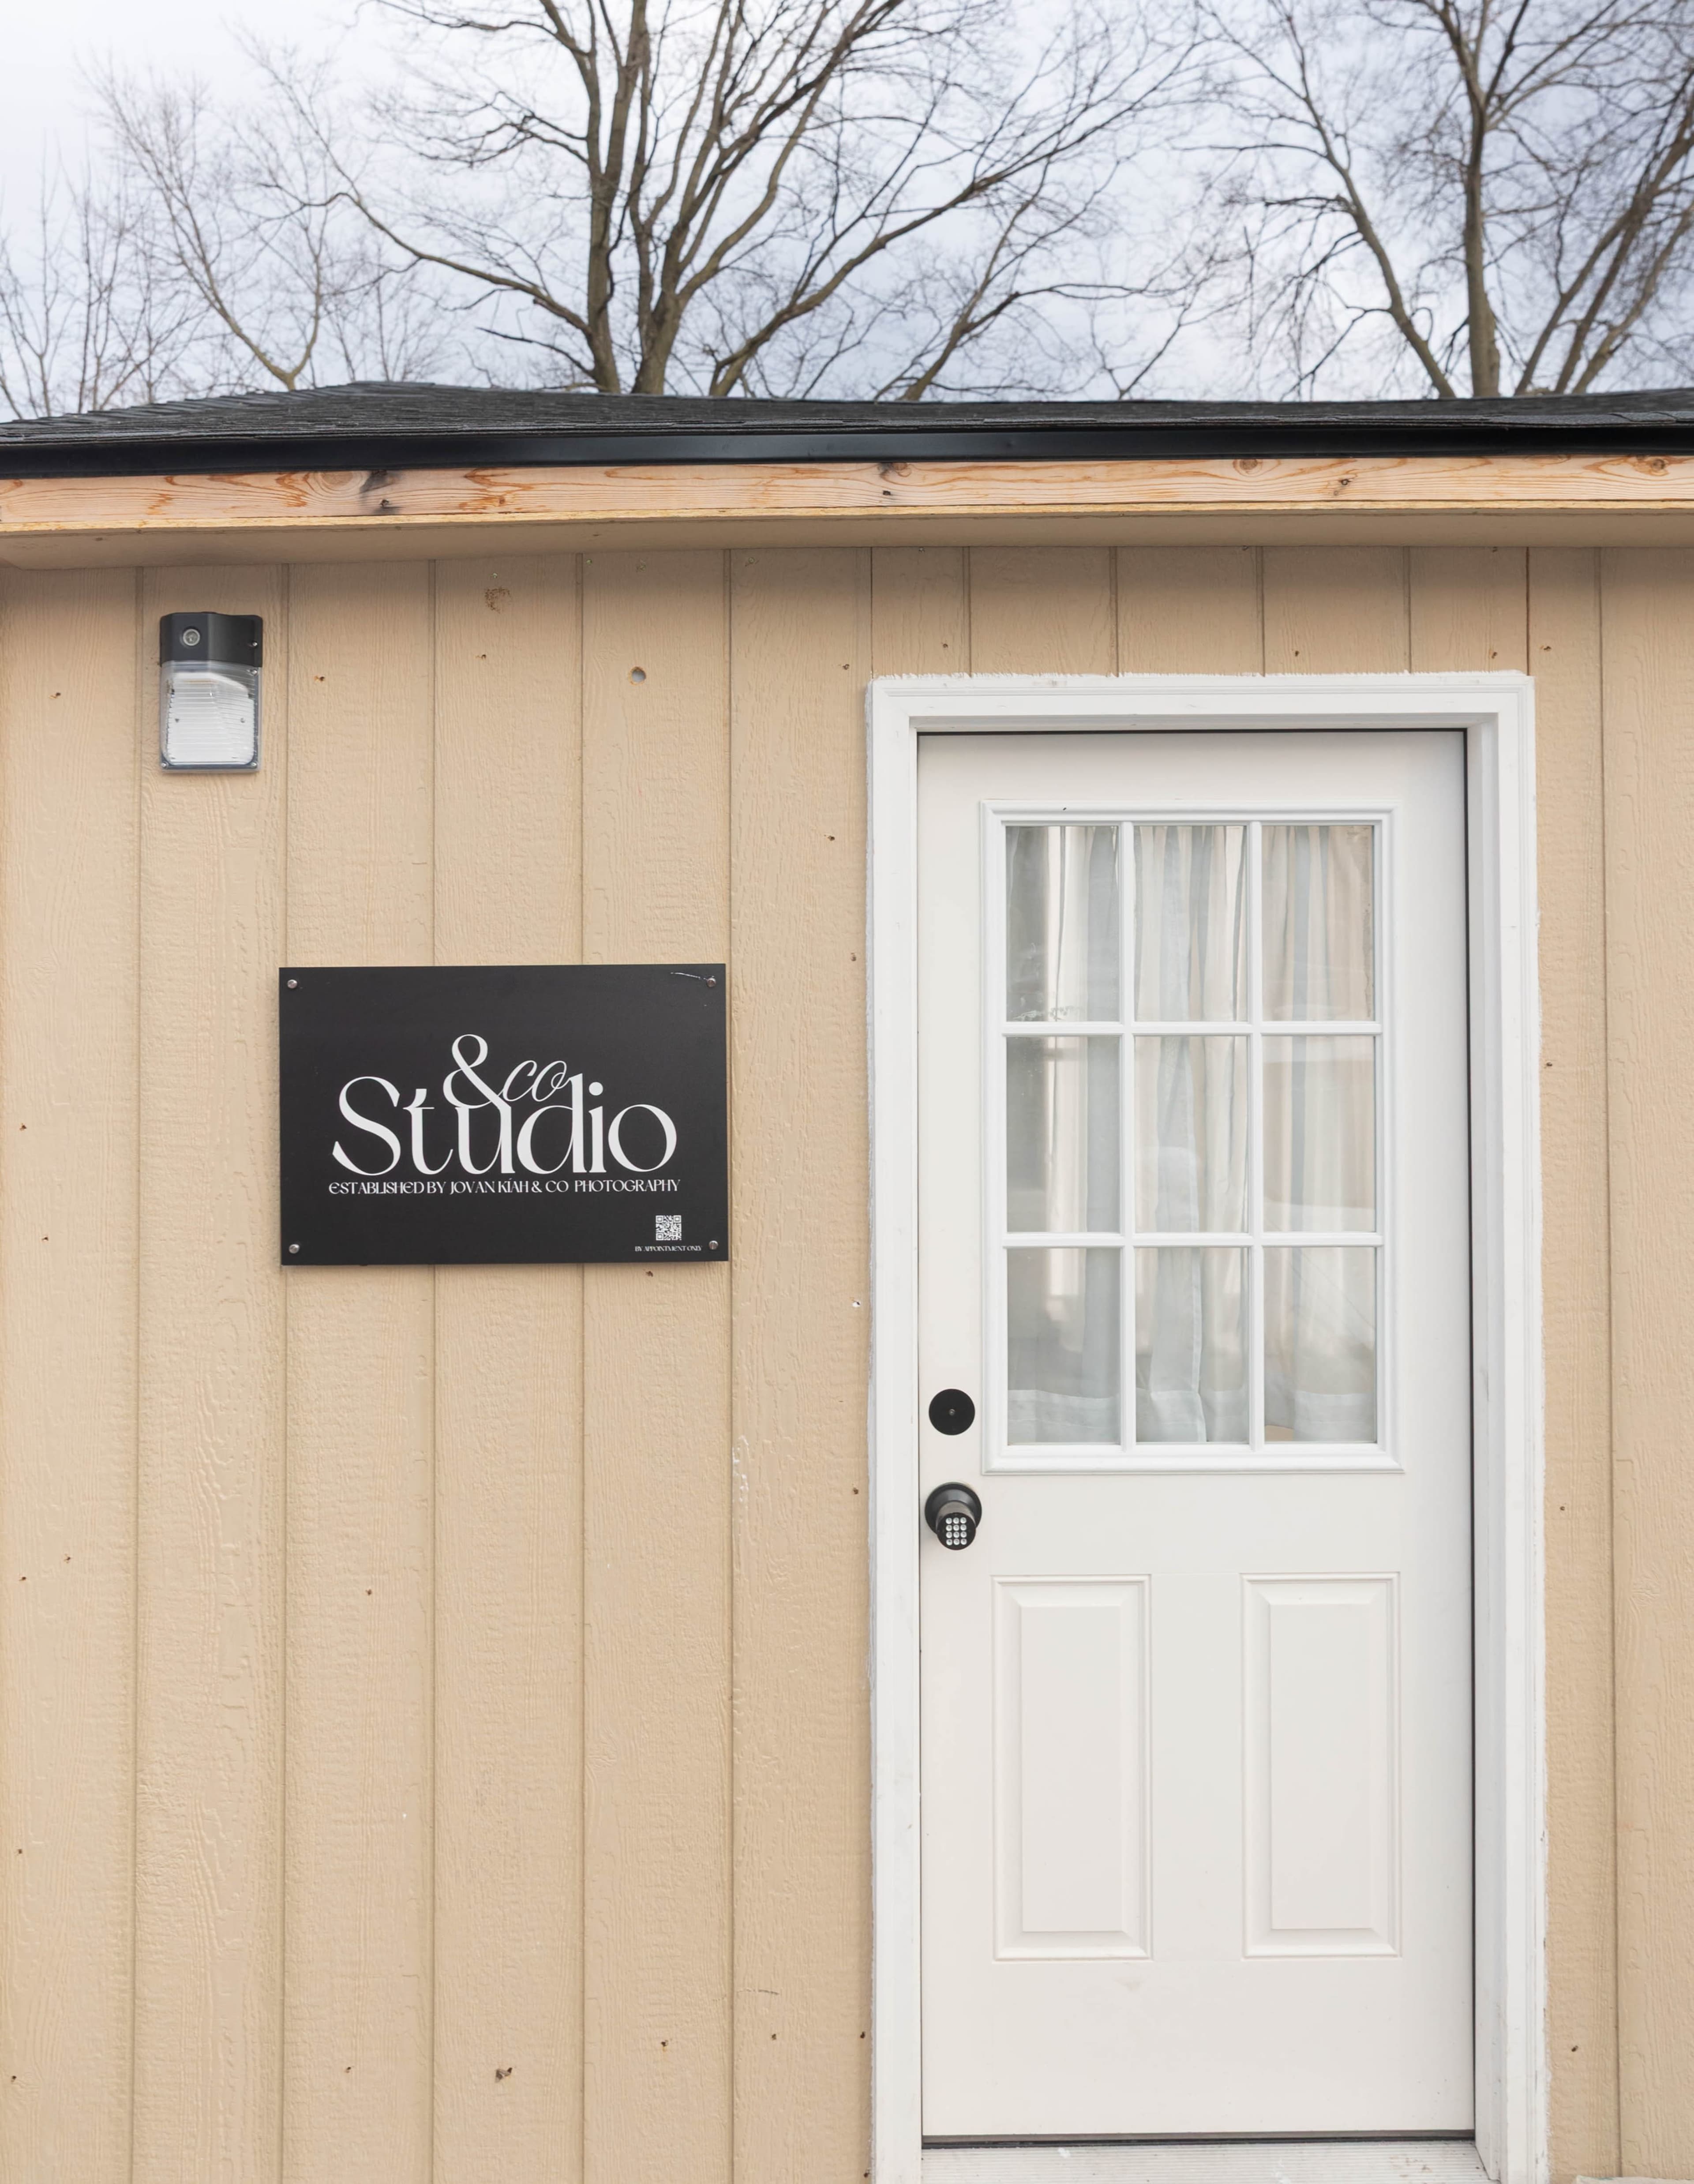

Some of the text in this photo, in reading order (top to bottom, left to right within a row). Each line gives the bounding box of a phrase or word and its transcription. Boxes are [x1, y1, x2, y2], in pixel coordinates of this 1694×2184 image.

[332, 1073, 677, 1176] Studio
[328, 1182, 425, 1194] ESTABLISHED
[427, 1181, 446, 1193] BY
[450, 1181, 495, 1195] JOVAN
[531, 1180, 543, 1193] &
[545, 1180, 569, 1193] CO
[574, 1179, 681, 1192] PHOTOGRAPHY
